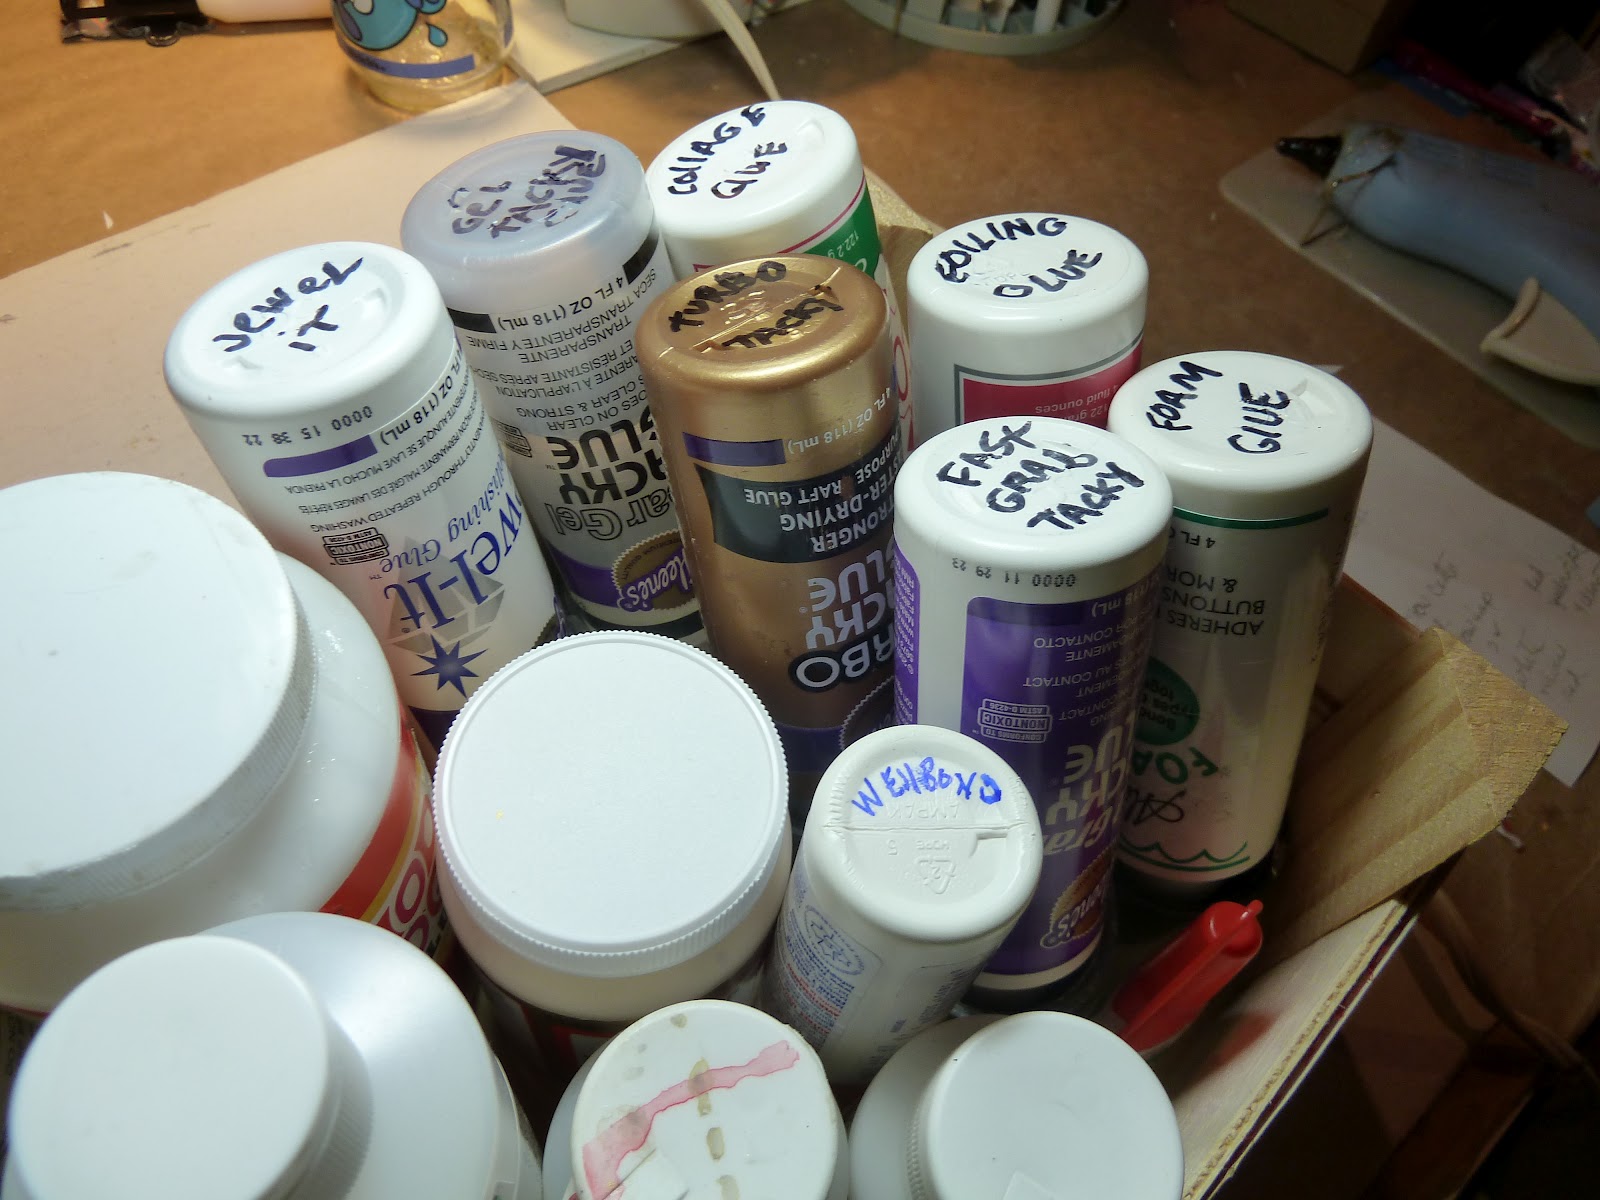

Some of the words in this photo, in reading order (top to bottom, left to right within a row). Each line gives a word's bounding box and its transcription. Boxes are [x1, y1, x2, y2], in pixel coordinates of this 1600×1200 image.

[594, 282, 614, 299] FL
[616, 276, 624, 288] 4
[632, 268, 655, 298] SECA
[570, 296, 592, 314] OZ
[668, 261, 787, 332] TURBO
[497, 316, 528, 331] mL)
[521, 295, 634, 349] TRANSPARENTE
[532, 304, 566, 326] (118
[722, 297, 844, 348] TACKY
[466, 335, 507, 351] FIRME
[510, 339, 521, 350] Y
[518, 315, 632, 363] TRANSPARENTE
[620, 339, 632, 353] ET
[594, 354, 638, 384] ARENTE
[438, 376, 453, 398] OZ
[582, 379, 591, 390] À
[590, 379, 637, 408] CLEAR
[622, 390, 647, 411] OES
[873, 393, 886, 410] FL
[1086, 388, 1110, 404] fluid
[1146, 361, 1223, 431] FOAM
[413, 392, 439, 424] (118
[516, 406, 574, 418] STRONG
[576, 402, 588, 412] &
[598, 406, 619, 421] ON
[1035, 398, 1083, 414] ounces
[331, 406, 372, 431] 0000
[546, 415, 594, 431] CLEAR
[855, 407, 873, 429] OZ
[301, 425, 320, 440] 15
[380, 420, 411, 445] mL)
[823, 419, 852, 443] (118
[242, 434, 263, 446] 22
[788, 435, 819, 454] mL)
[406, 443, 417, 455] SE
[384, 452, 404, 469] LAVE
[342, 464, 383, 485] MUCHO
[388, 470, 420, 492] MALGRÉ
[421, 456, 465, 496] THROUGH
[285, 480, 325, 495] PRENDA
[328, 478, 341, 489] LA
[371, 485, 386, 498] DES
[798, 479, 842, 504] RAFT
[333, 493, 369, 510] LAVAGES
[743, 488, 792, 507] GLUE
[1026, 461, 1145, 530] TACKY
[368, 493, 420, 522] REPEATED
[310, 513, 368, 533] WASHING
[544, 503, 623, 541] Gel
[330, 538, 383, 555] NONTOXIC
[1180, 530, 1200, 546] FL
[1206, 538, 1216, 548] 4
[808, 535, 894, 612] LUE
[951, 558, 967, 572] 23
[975, 565, 991, 579] 29
[627, 550, 690, 608] leene's
[1004, 572, 1020, 585] 11
[1031, 574, 1076, 588] 0000
[1167, 566, 1215, 592] MOR
[1222, 578, 1238, 593] &
[1162, 586, 1265, 615] BUTTONS
[1167, 609, 1265, 636] ADHERES
[1034, 627, 1113, 648] CONTACTO
[1023, 671, 1091, 687] CONTACT
[1096, 664, 1111, 677] AU
[984, 713, 1045, 730] NONTOXIC
[986, 728, 995, 736] TO
[997, 730, 1041, 740] CONFORMS
[1132, 747, 1218, 785] FOA
